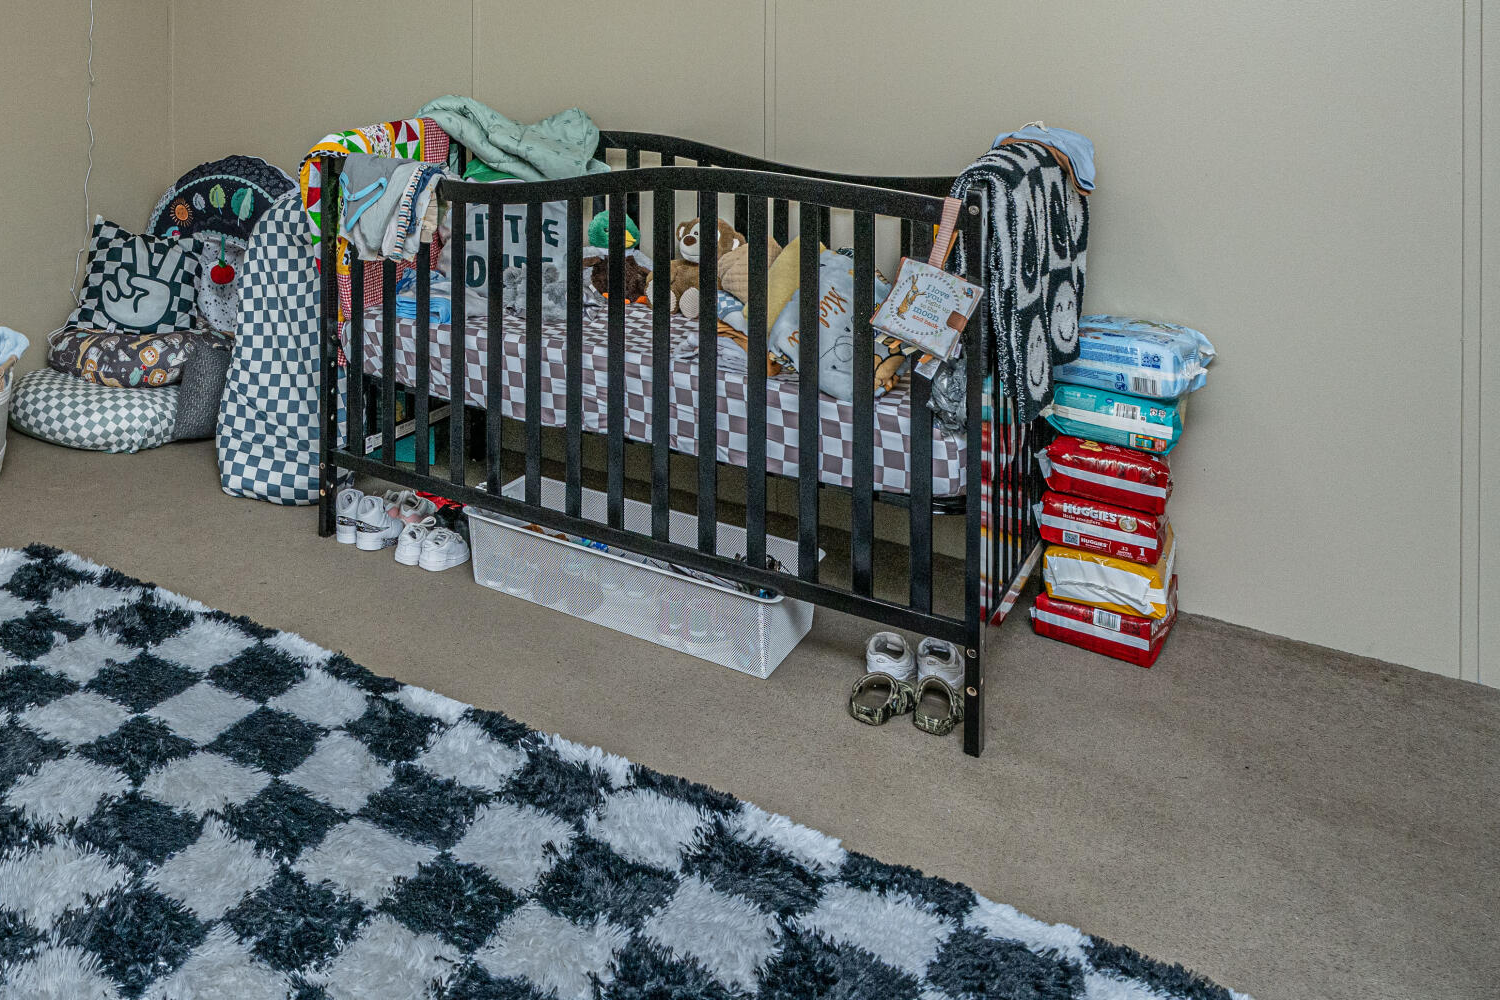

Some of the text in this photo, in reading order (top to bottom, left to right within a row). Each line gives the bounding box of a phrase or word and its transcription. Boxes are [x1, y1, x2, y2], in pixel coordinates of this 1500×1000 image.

[925, 291, 943, 304] you
[931, 285, 950, 300] love
[913, 306, 940, 322] moon
[1062, 502, 1117, 523] HUGGIES
[1080, 536, 1108, 548] HUGGIES
